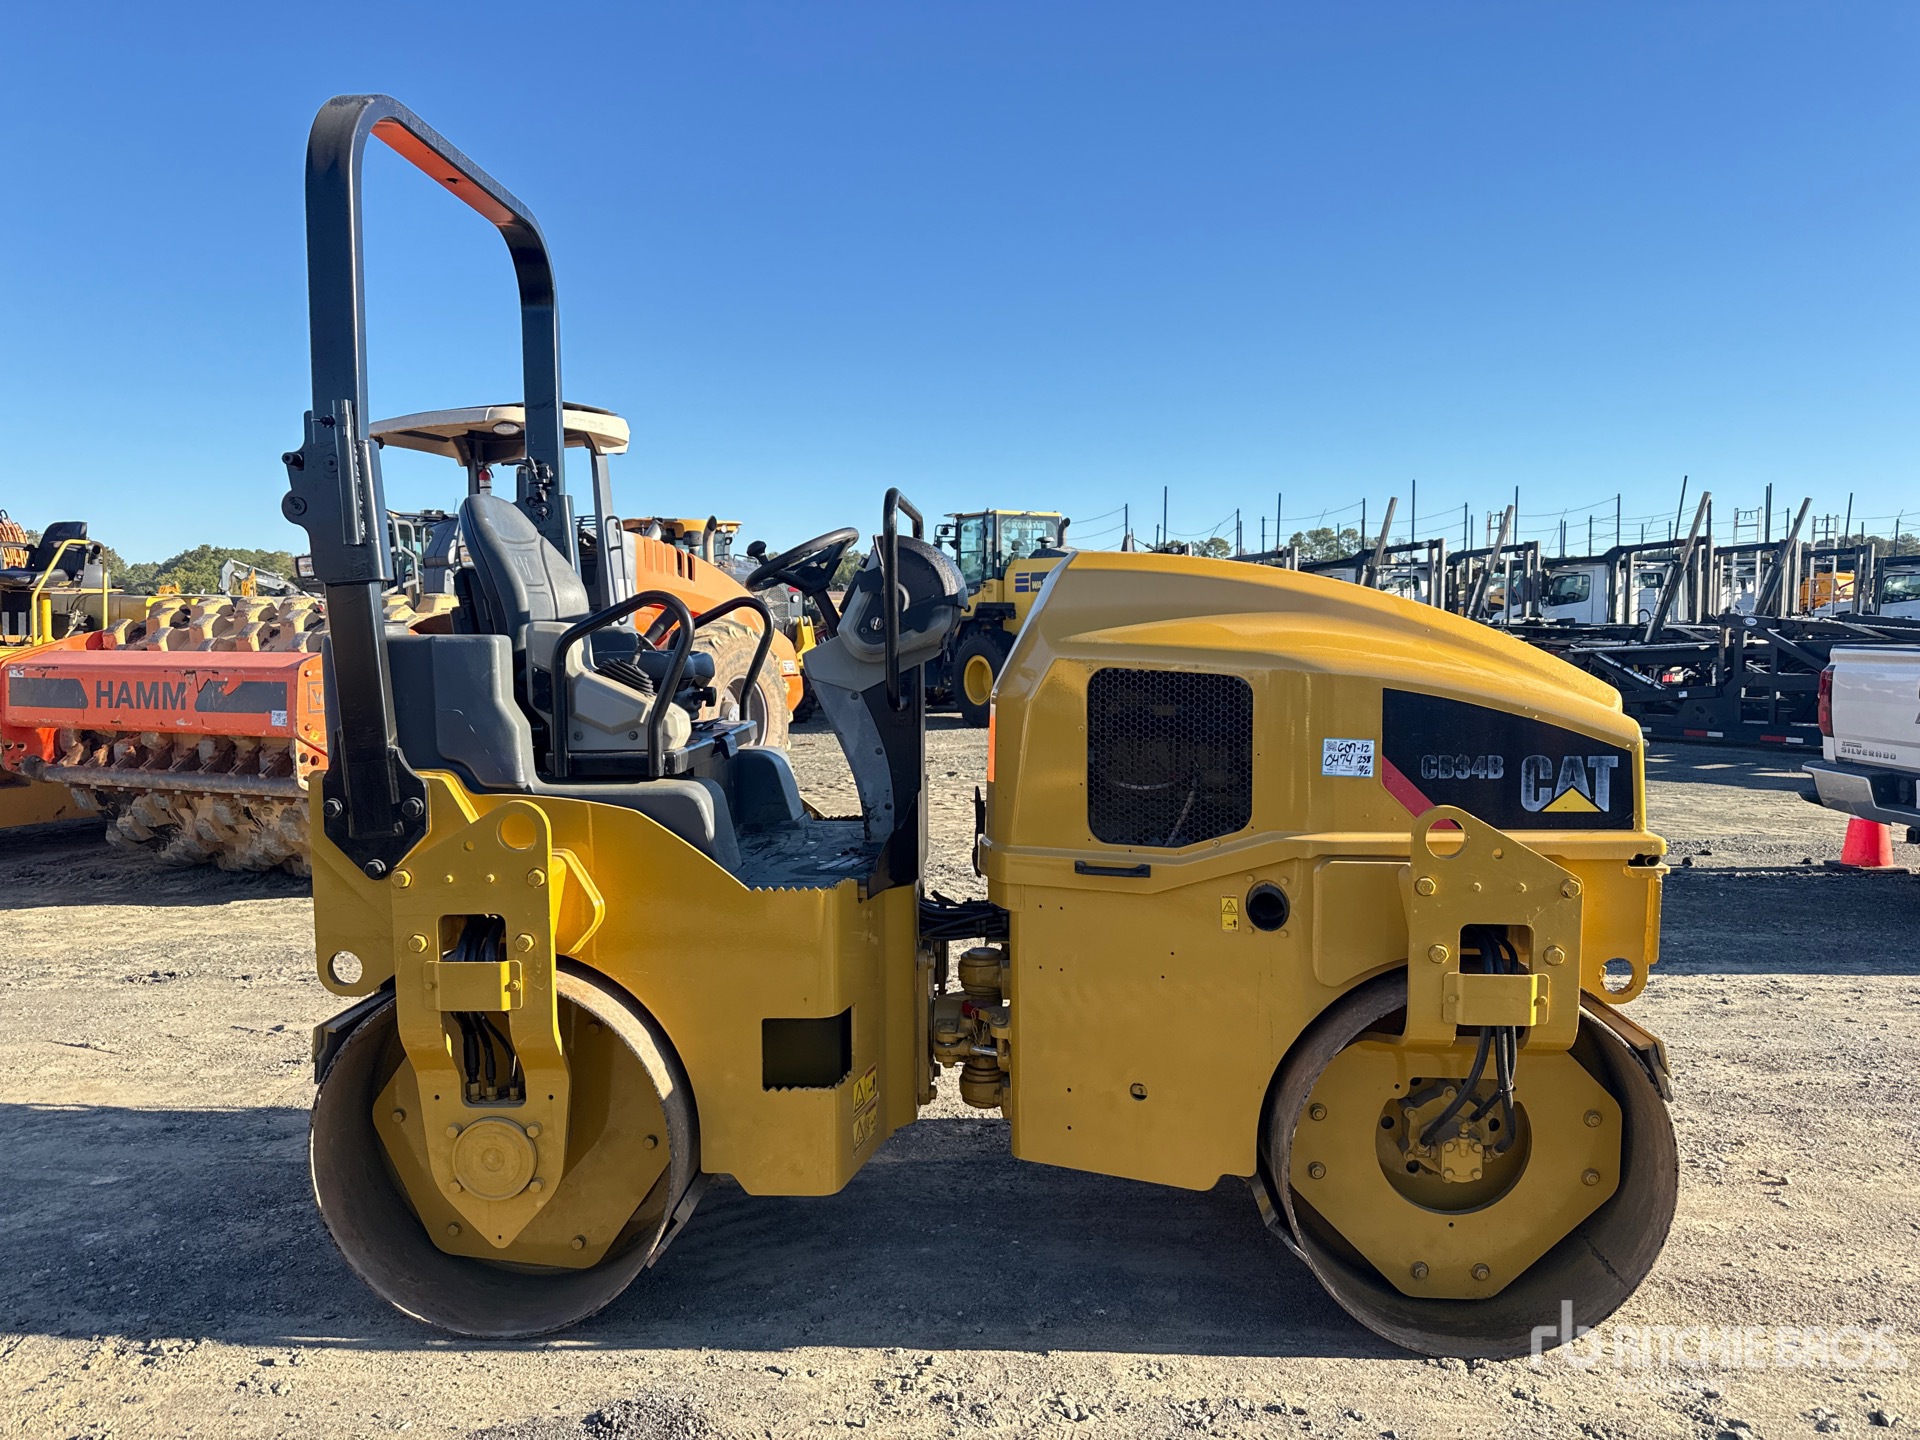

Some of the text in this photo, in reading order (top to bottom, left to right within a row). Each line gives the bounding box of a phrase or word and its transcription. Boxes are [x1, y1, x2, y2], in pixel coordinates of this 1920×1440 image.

[1011, 521, 1046, 530] KOMATSU
[95, 680, 187, 710] HAMM
[1324, 753, 1354, 766] 0474
[1841, 746, 1897, 760] SILVERADO
[1420, 754, 1504, 779] CB34B
[1520, 755, 1618, 812] CAT
